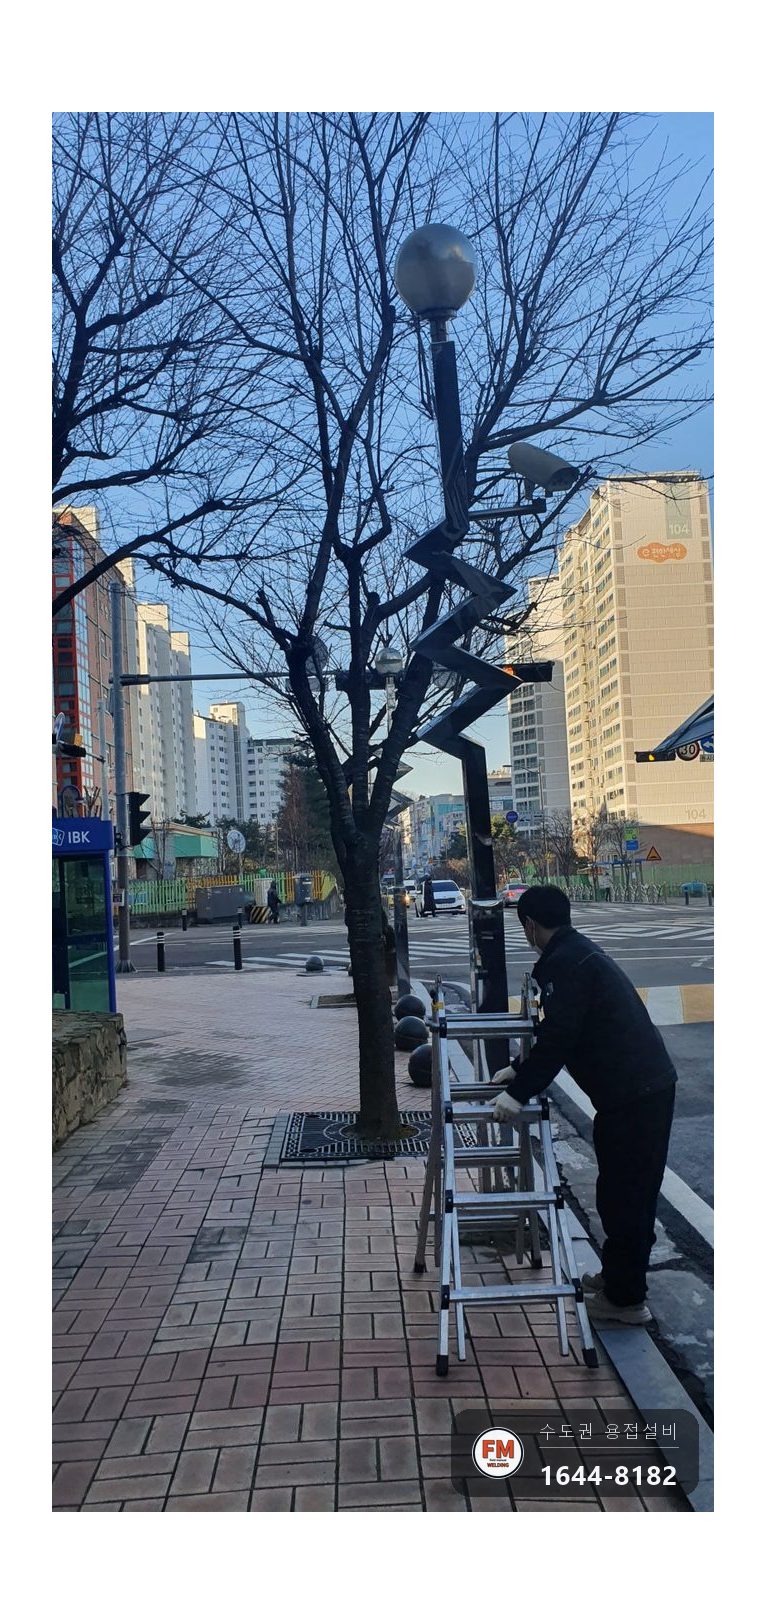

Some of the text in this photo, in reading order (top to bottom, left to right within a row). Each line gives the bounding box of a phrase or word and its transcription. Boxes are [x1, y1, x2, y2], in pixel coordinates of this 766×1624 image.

[669, 523, 688, 535] 104
[680, 744, 695, 754] 30
[685, 808, 706, 821] 104
[68, 831, 90, 844] IBK
